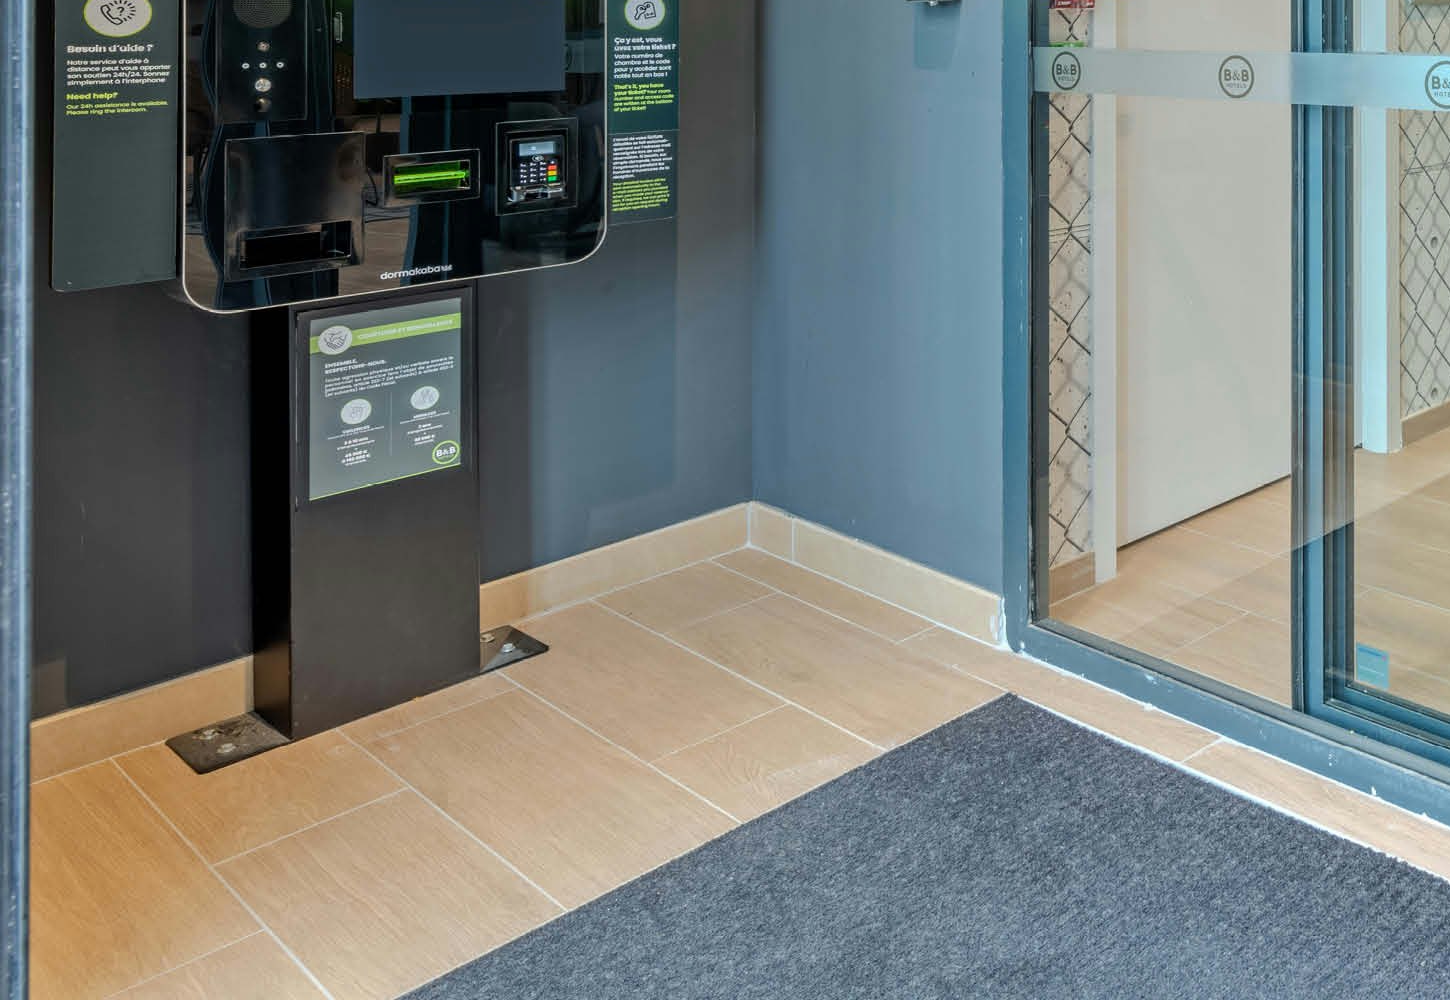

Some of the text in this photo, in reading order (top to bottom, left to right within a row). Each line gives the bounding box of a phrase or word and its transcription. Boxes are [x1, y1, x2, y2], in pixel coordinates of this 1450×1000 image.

[67, 45, 107, 53] Besoin
[108, 44, 145, 53] d'aide
[1056, 63, 1077, 76] B&B
[1224, 69, 1249, 82] B&B
[380, 265, 440, 280] dormakaba
[436, 446, 456, 458] B&B
